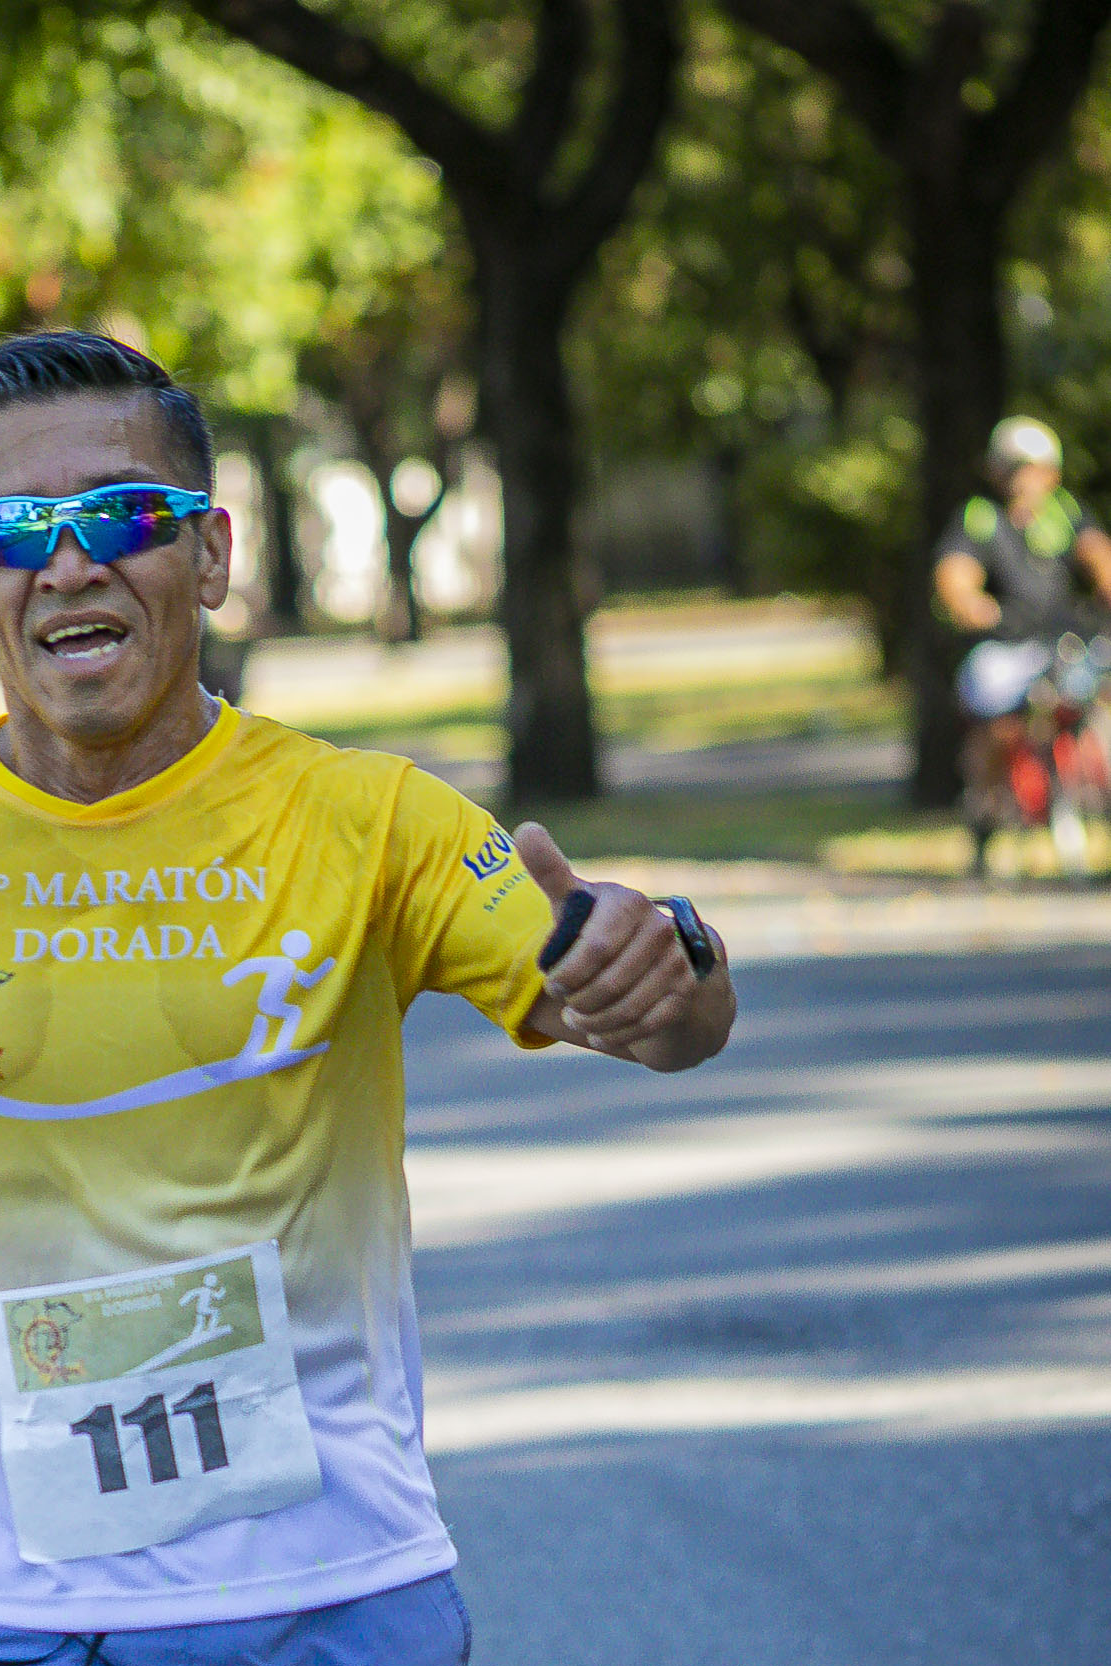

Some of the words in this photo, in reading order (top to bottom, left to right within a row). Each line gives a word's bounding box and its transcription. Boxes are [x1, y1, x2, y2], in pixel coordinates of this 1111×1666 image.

[22, 856, 267, 908] MARATÓN
[11, 924, 227, 963] DORADA
[70, 1380, 229, 1493] 111
